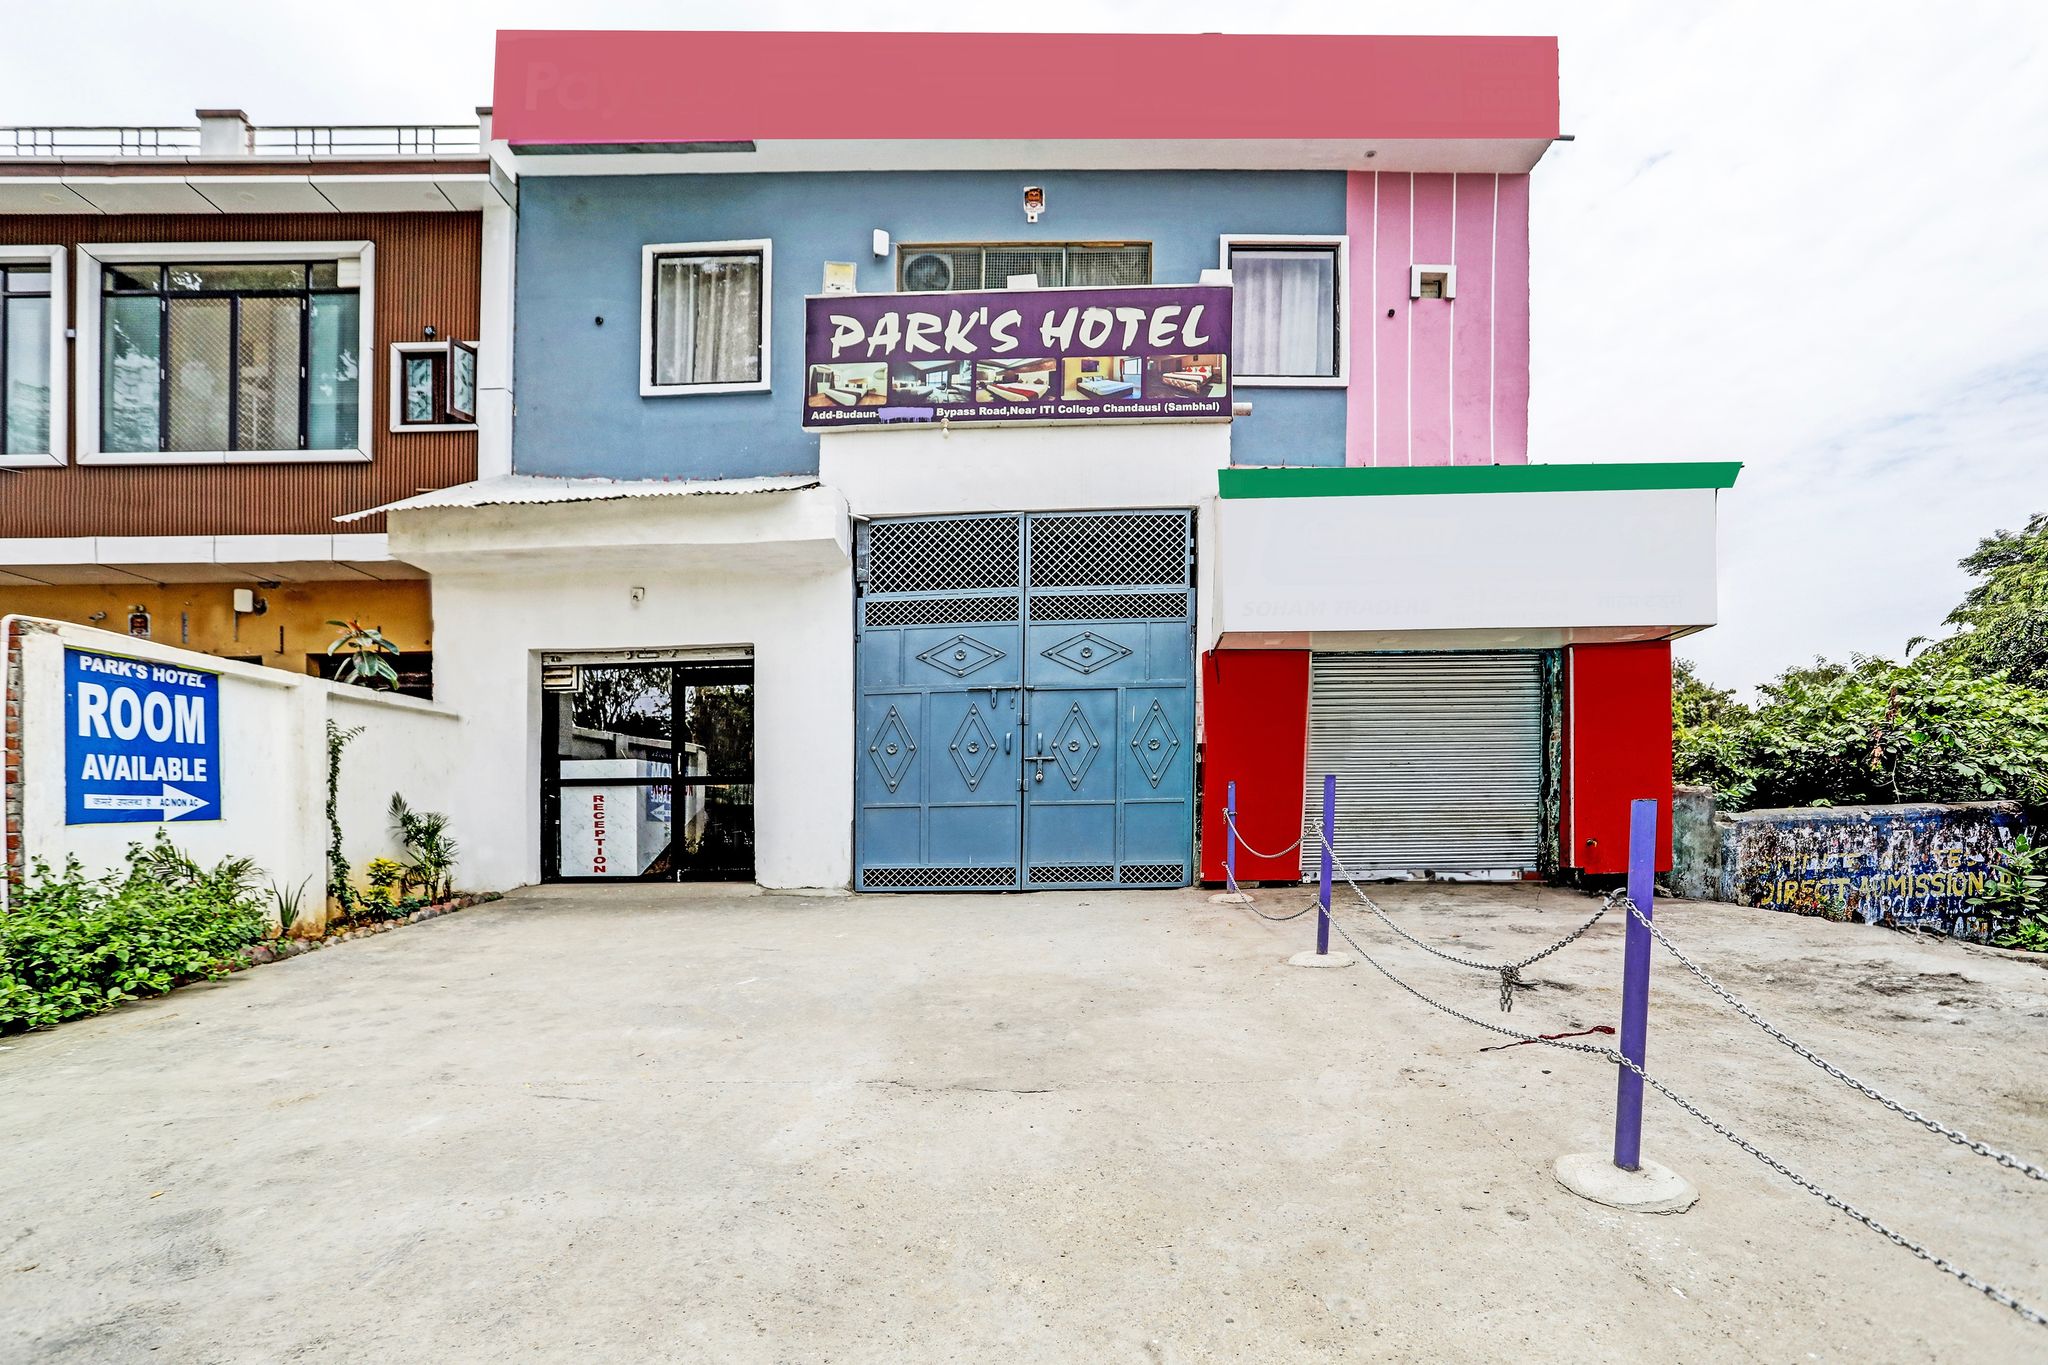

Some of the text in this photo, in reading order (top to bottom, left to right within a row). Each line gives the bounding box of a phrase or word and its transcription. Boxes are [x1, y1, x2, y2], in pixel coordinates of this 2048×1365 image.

[829, 304, 1211, 358] PARK'S HOTEL
[936, 408, 976, 418] Bypass
[979, 405, 1036, 416] Road,Near
[1039, 405, 1055, 414] ITI
[1058, 404, 1100, 415] College
[1103, 403, 1161, 413] Chandausi
[1164, 401, 1220, 413] (Sambhal)
[79, 655, 206, 688] PARK'S HOTEL
[77, 681, 206, 745] ROOM
[81, 754, 208, 782] AVAILABLE
[593, 795, 607, 873] RECEPTION
[1859, 871, 1985, 899] ADMISSION
